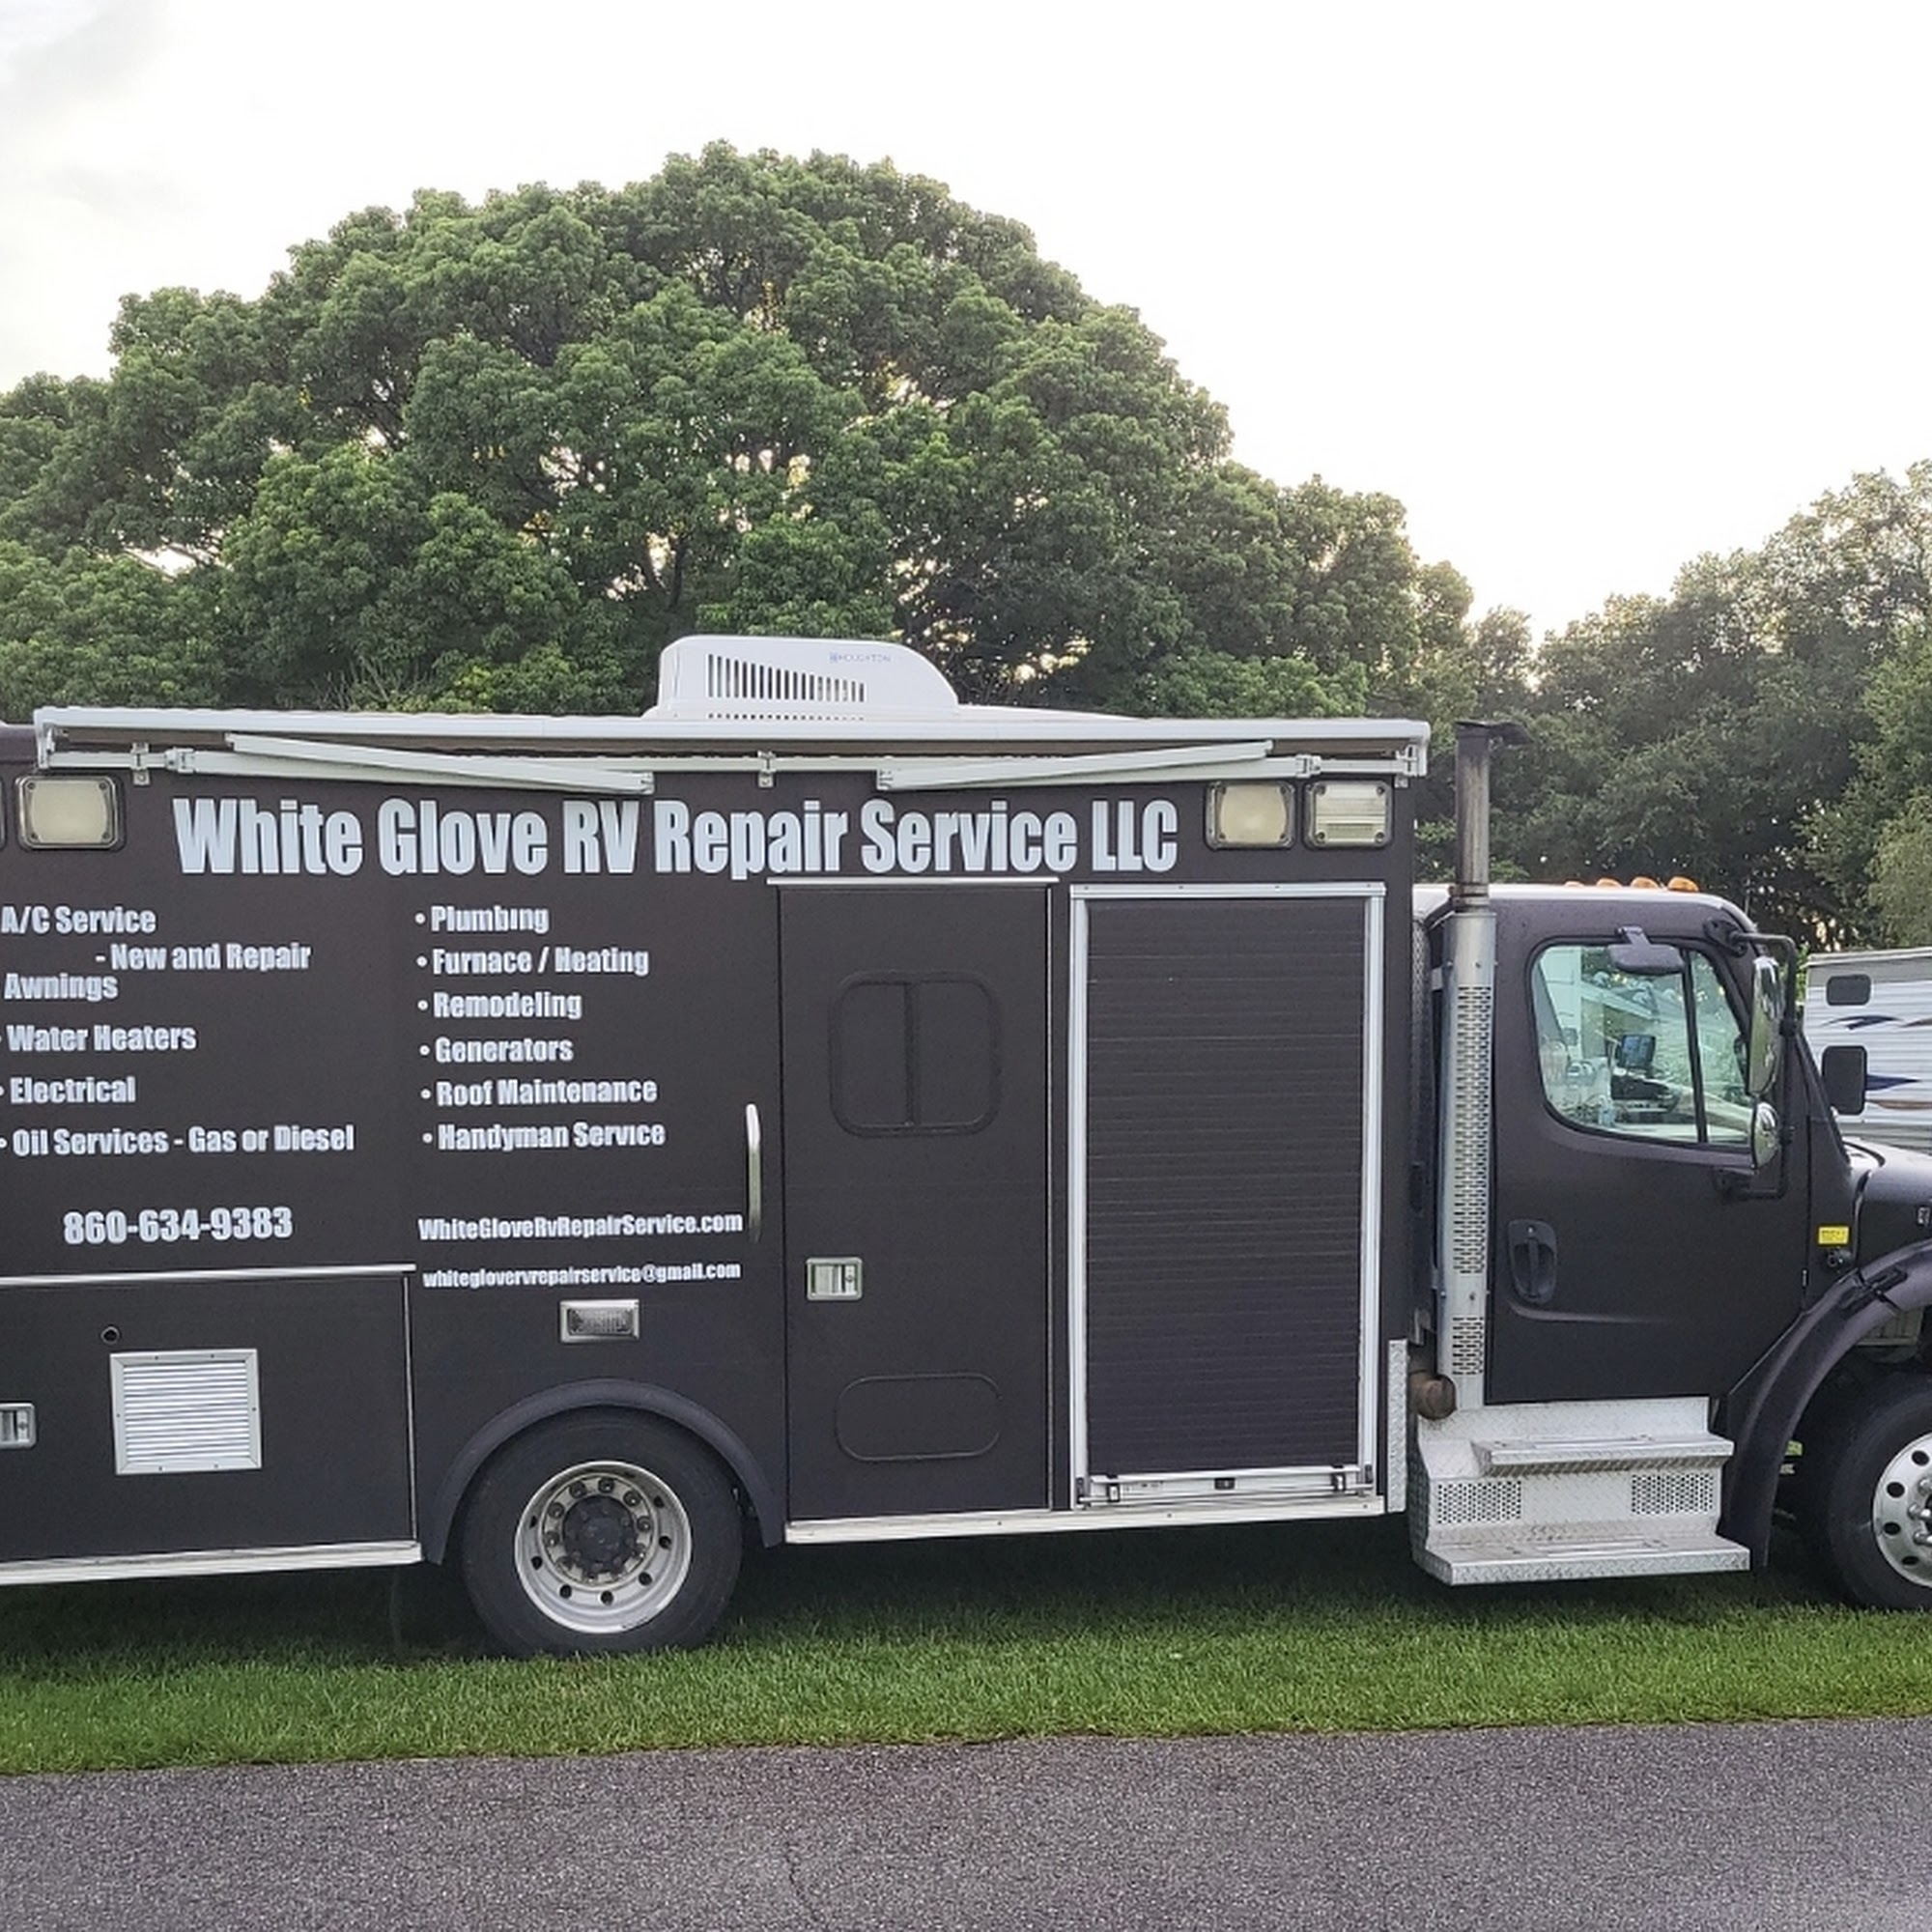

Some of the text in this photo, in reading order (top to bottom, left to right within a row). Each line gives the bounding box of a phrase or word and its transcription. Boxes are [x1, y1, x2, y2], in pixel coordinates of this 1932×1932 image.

[172, 798, 1178, 881] White Glove RV Repair Service LLC
[0, 905, 156, 934] A/C Service
[430, 904, 550, 934] Plumbing
[110, 943, 167, 971] New
[171, 942, 221, 970] and
[225, 941, 312, 972] Repair
[432, 948, 533, 975] Furnace
[554, 946, 649, 977] Heating
[3, 972, 119, 1003] Awnings
[433, 990, 582, 1020] Remodeling
[6, 1024, 197, 1052] Water Heaters
[435, 1036, 574, 1064] Generators
[10, 1075, 136, 1104] Electrical
[436, 1078, 658, 1107] Roof Maintenance
[12, 1128, 49, 1157] Oil
[53, 1127, 170, 1155] Services
[188, 1125, 238, 1153] Gas
[241, 1129, 270, 1152] or
[273, 1123, 355, 1151] Diesel
[438, 1122, 666, 1152] Handyman Service
[63, 1206, 293, 1245] 860-634-9383
[417, 1213, 744, 1240] WhiteGloveRvRepairService.com
